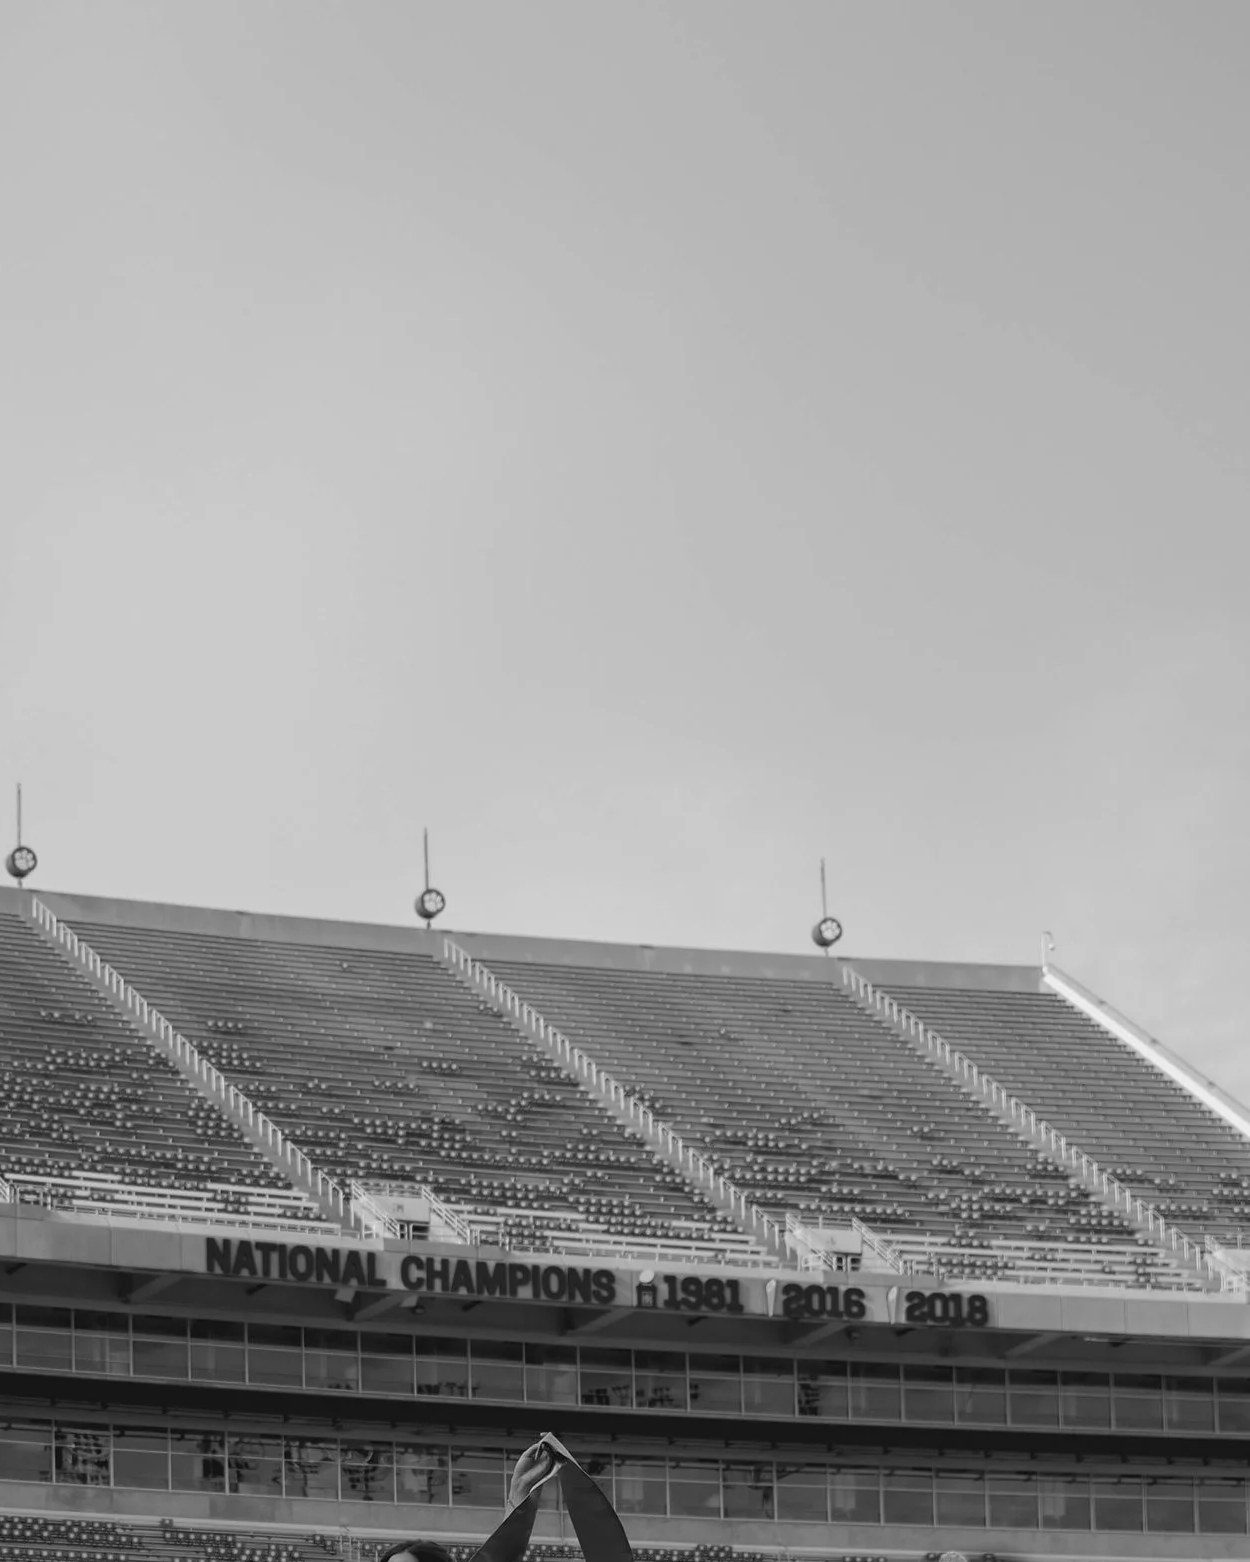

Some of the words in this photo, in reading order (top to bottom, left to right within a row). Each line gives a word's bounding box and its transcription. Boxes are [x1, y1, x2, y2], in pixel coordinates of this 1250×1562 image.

[205, 1237, 388, 1288] NATIONAL
[400, 1255, 617, 1305] CHAMPIONS
[663, 1274, 745, 1315] 1981
[782, 1283, 867, 1320] 2016
[905, 1291, 989, 1328] 2018
